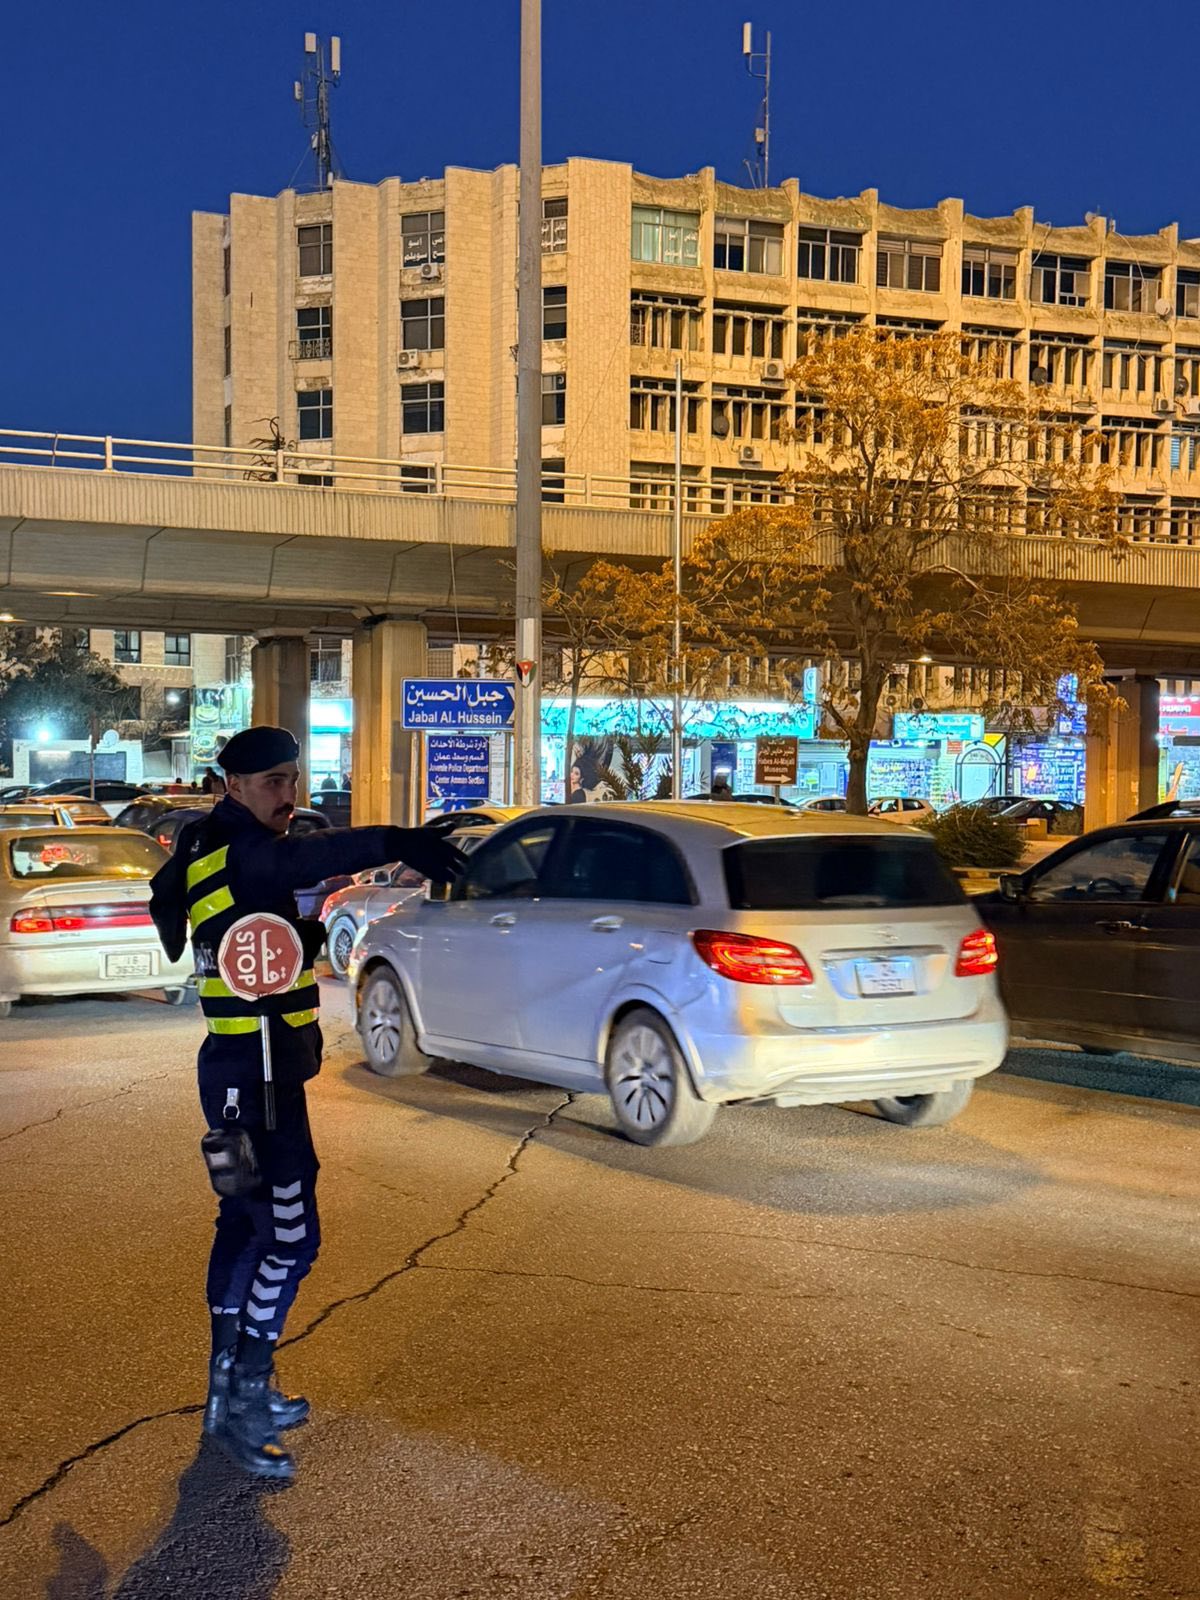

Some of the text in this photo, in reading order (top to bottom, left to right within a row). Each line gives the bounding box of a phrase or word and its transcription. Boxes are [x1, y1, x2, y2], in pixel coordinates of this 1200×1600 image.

[406, 683, 505, 707] جبل الحسين
[408, 710, 437, 724] Jabal
[457, 711, 502, 725] Hussein
[433, 752, 451, 762] عمان
[448, 763, 463, 772] Police
[463, 764, 489, 774] Department
[451, 776, 468, 784] Amman
[468, 776, 485, 785] Section
[235, 930, 257, 987] STOP
[260, 929, 287, 985] قف
